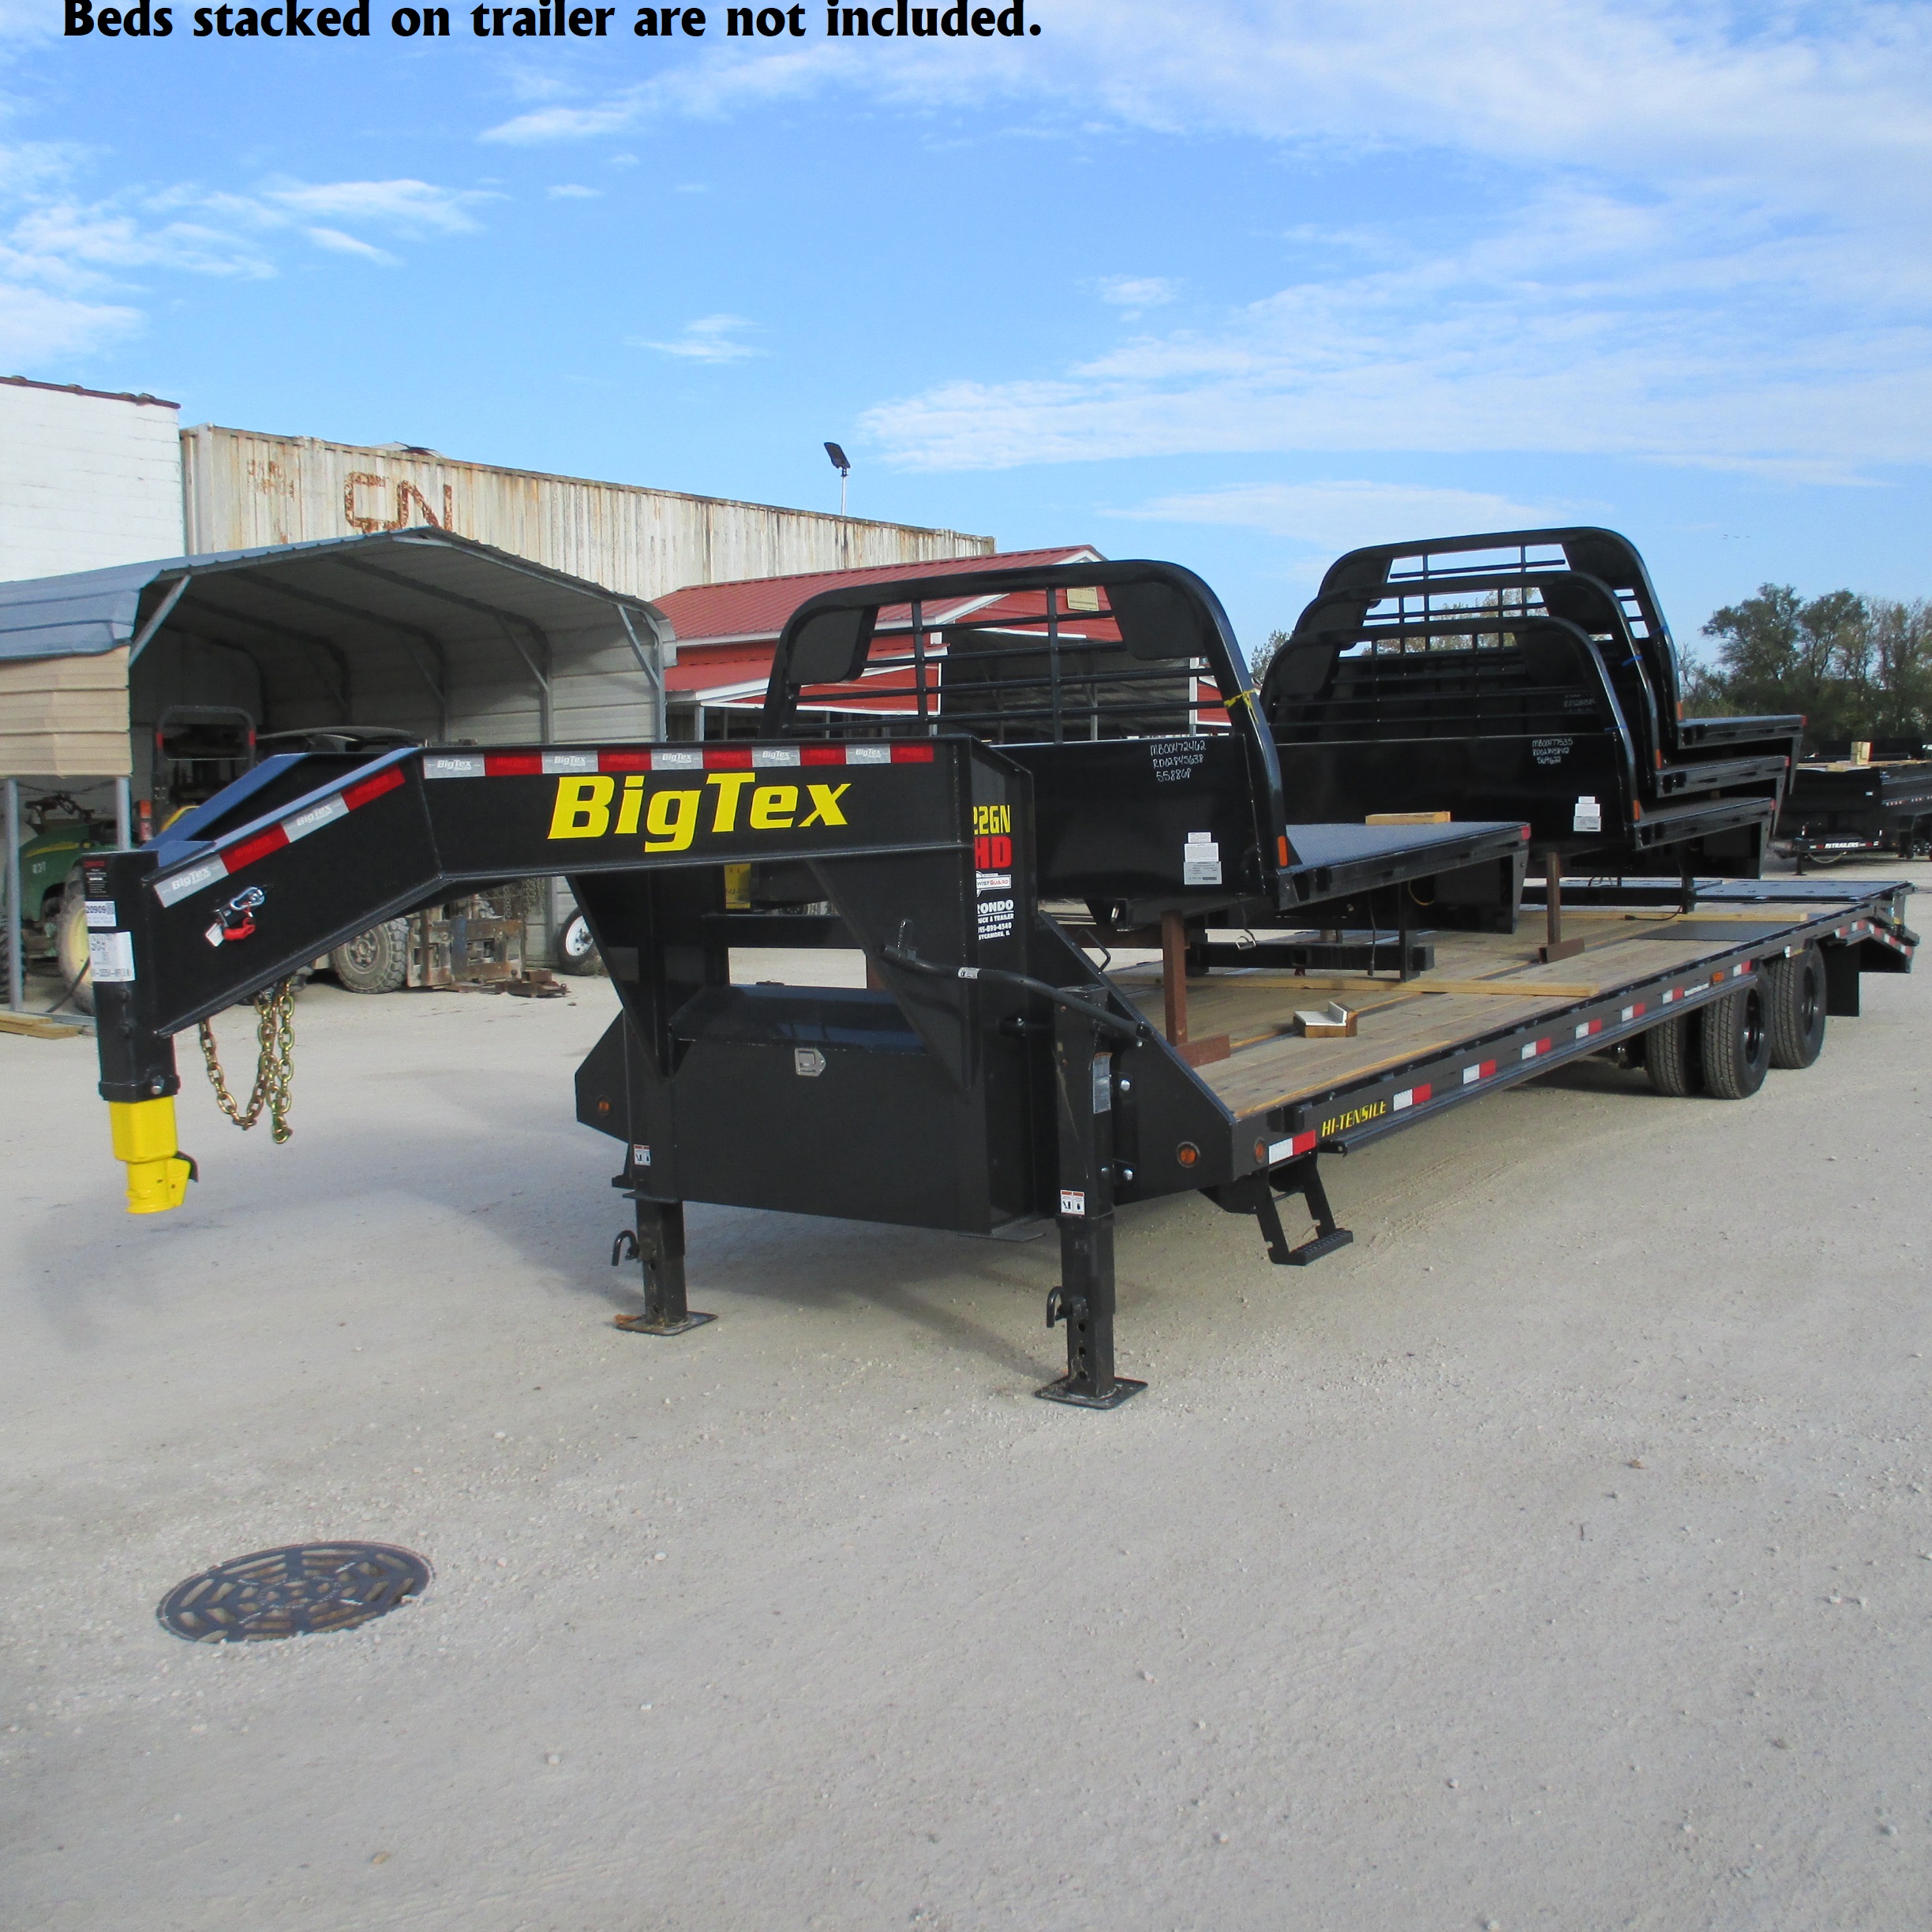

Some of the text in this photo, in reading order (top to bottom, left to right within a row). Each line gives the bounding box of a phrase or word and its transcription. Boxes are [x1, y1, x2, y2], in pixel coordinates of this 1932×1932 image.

[437, 759, 472, 770] BigTex
[554, 755, 586, 766] BigTex
[547, 772, 852, 852] BigTex
[974, 836, 1013, 869] HD
[171, 866, 212, 891] BigTex
[994, 912, 1014, 923] TRAILER
[1321, 1100, 1387, 1137] HI-TENSILE
